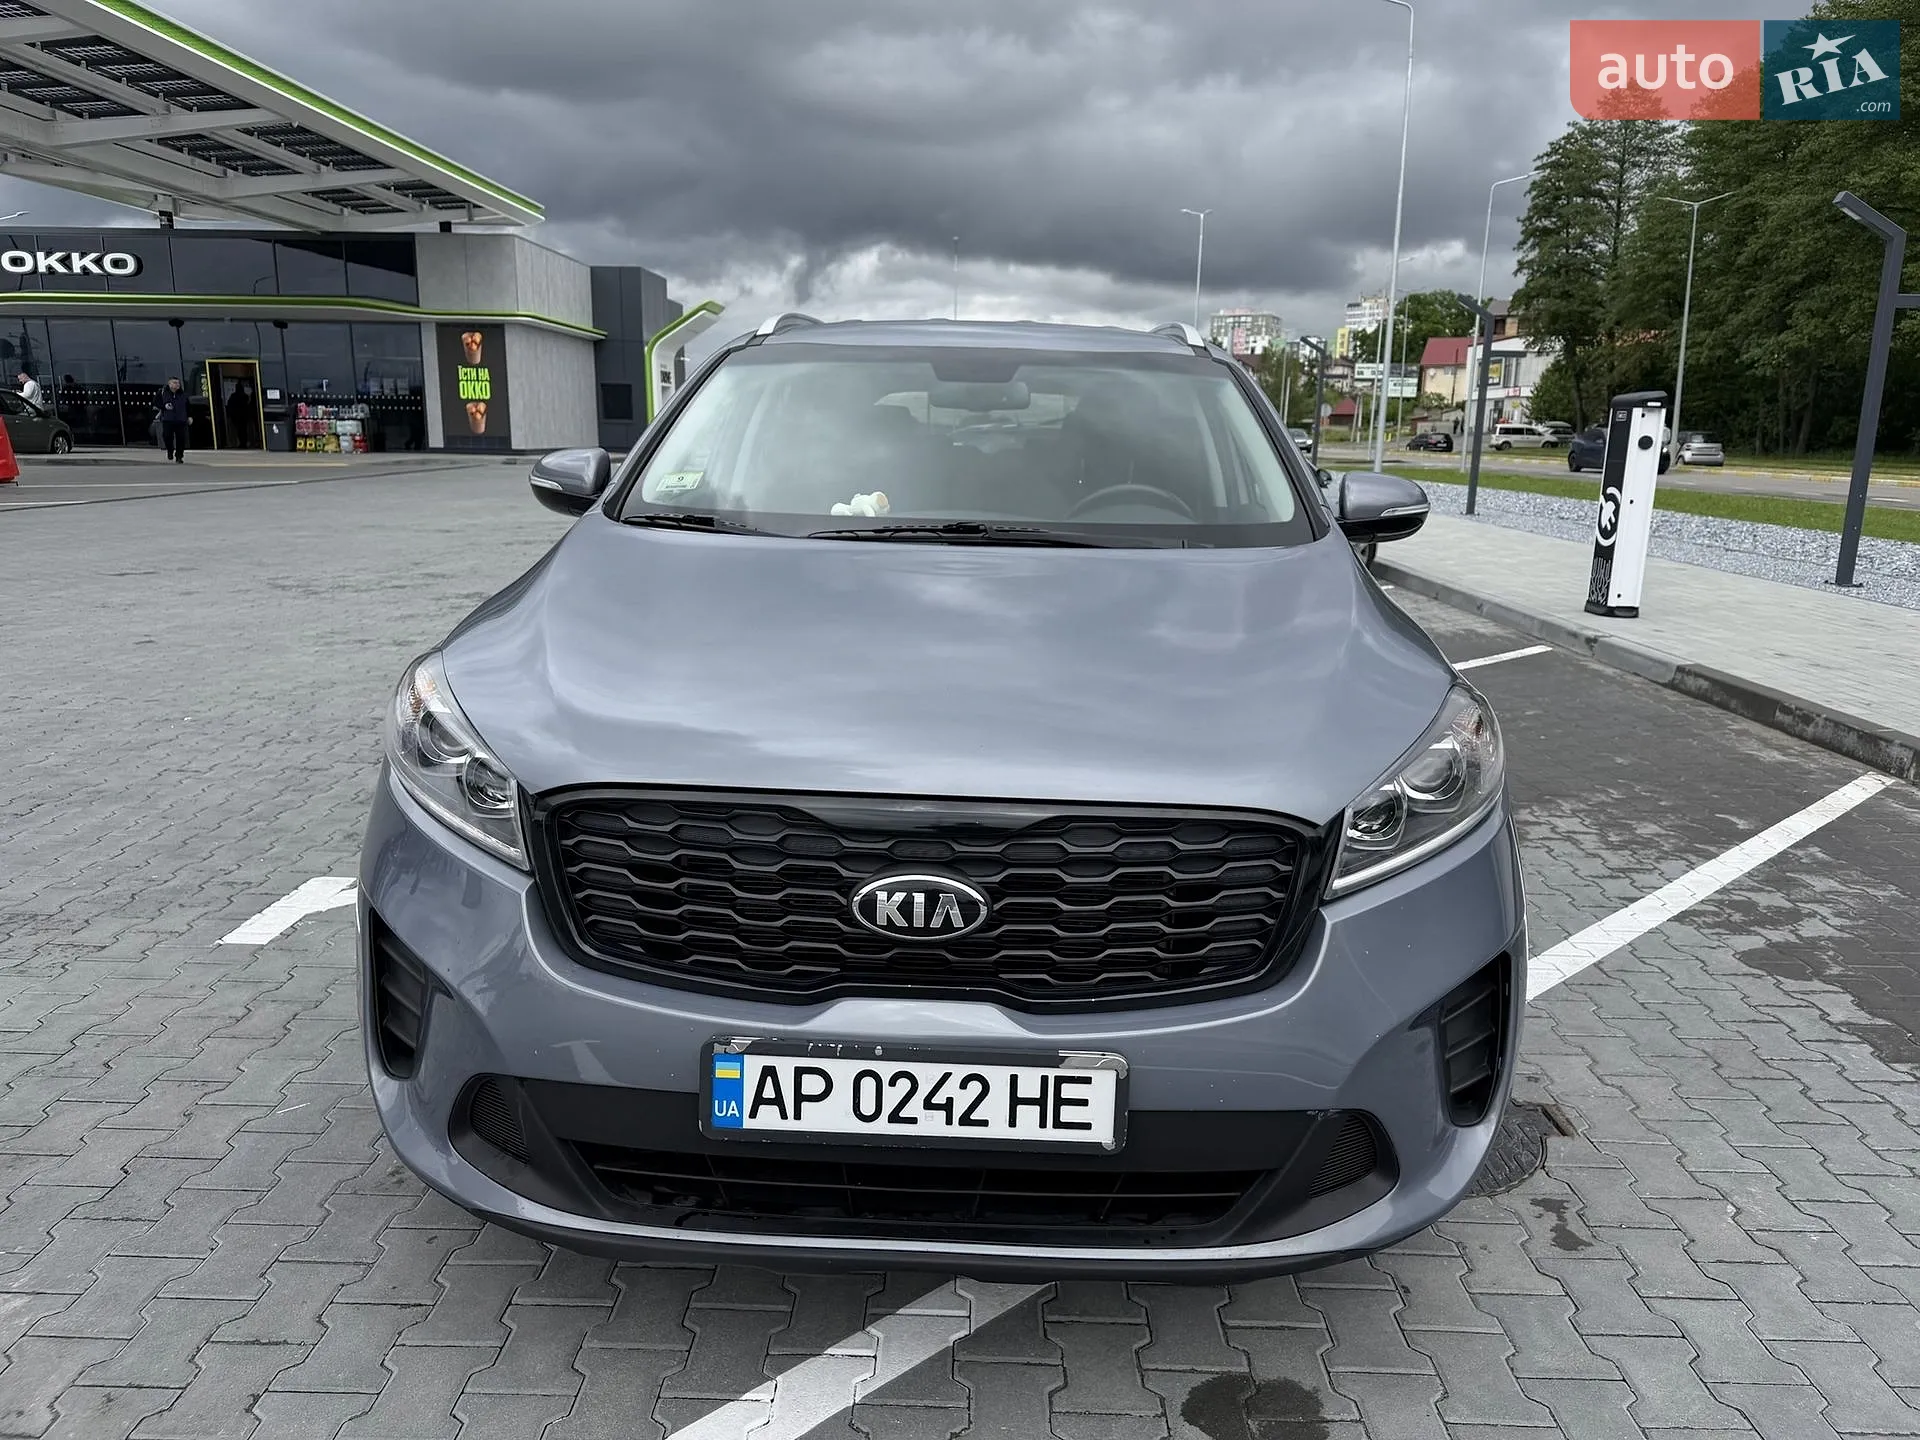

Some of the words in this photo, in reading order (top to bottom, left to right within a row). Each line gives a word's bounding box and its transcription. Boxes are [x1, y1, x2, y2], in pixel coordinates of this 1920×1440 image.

[1, 250, 136, 275] OKKO
[875, 890, 965, 928] KIA
[714, 1099, 740, 1118] UA
[748, 1065, 834, 1121] AP
[852, 1069, 990, 1128] 0242
[1008, 1074, 1093, 1131] HE
